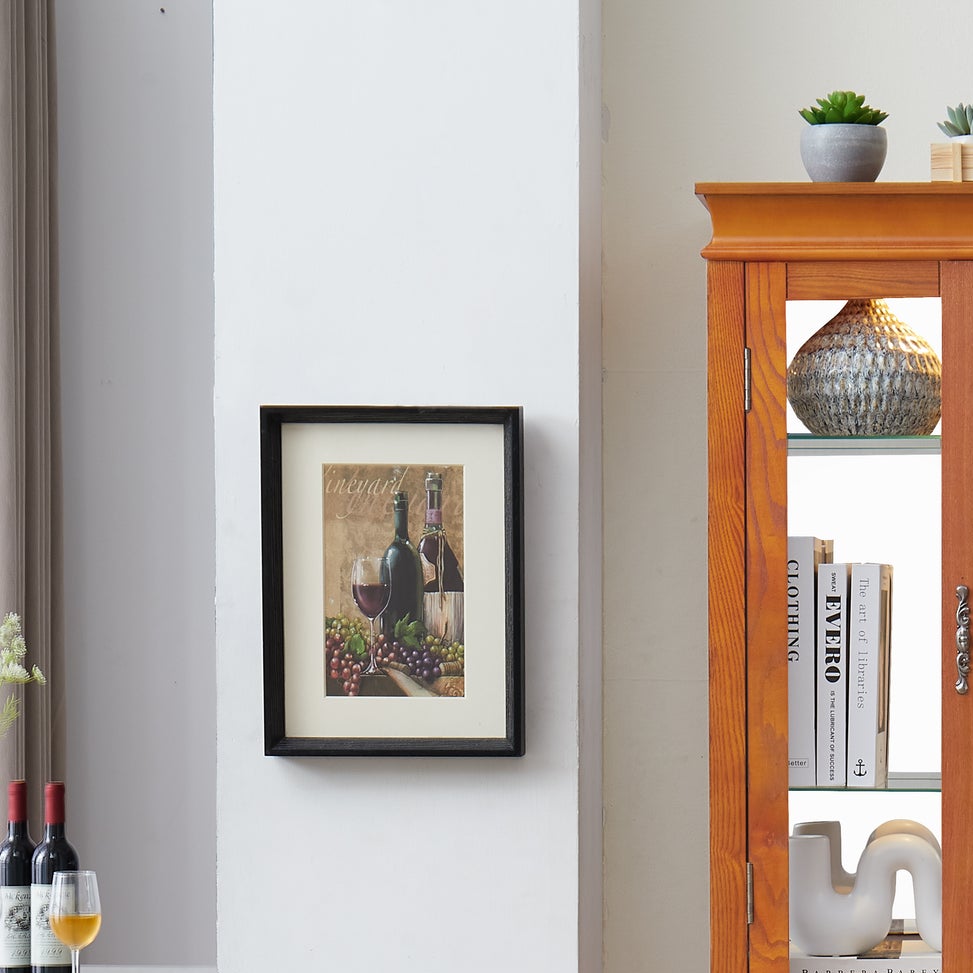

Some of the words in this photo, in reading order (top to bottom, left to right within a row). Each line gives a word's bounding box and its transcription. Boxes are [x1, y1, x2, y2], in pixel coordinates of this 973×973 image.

[323, 464, 409, 518] ineyard
[859, 578, 870, 598] The
[787, 559, 800, 663] CLOTHING
[859, 604, 867, 623] art
[824, 594, 841, 683] EVERO
[858, 630, 869, 644] of
[856, 651, 869, 709] libraries
[829, 744, 835, 752] OF
